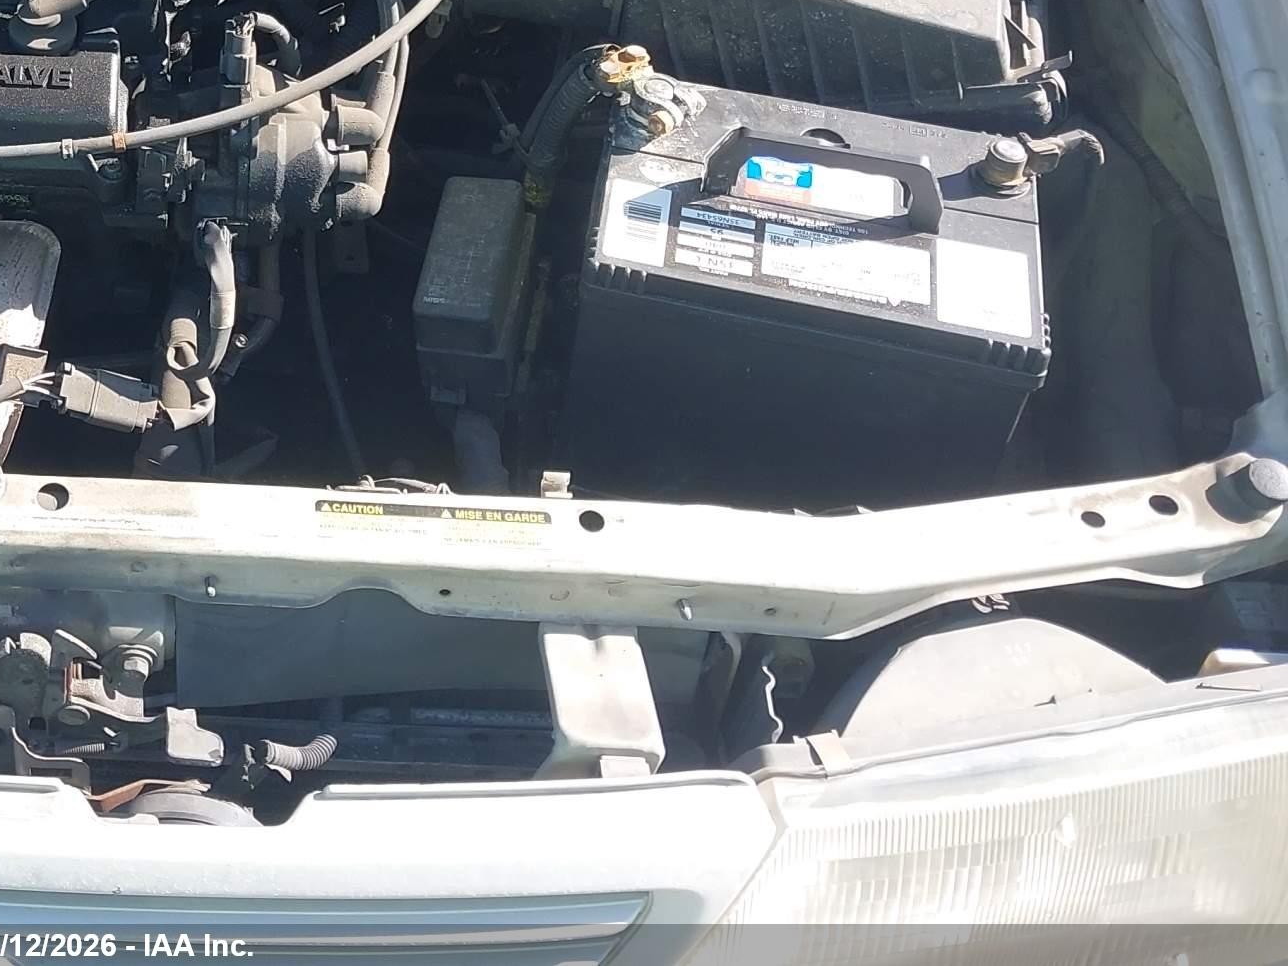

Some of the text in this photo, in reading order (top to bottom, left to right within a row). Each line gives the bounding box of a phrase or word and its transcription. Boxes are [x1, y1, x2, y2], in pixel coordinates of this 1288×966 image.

[332, 503, 546, 523] CAUTION MISE EN GARDE
